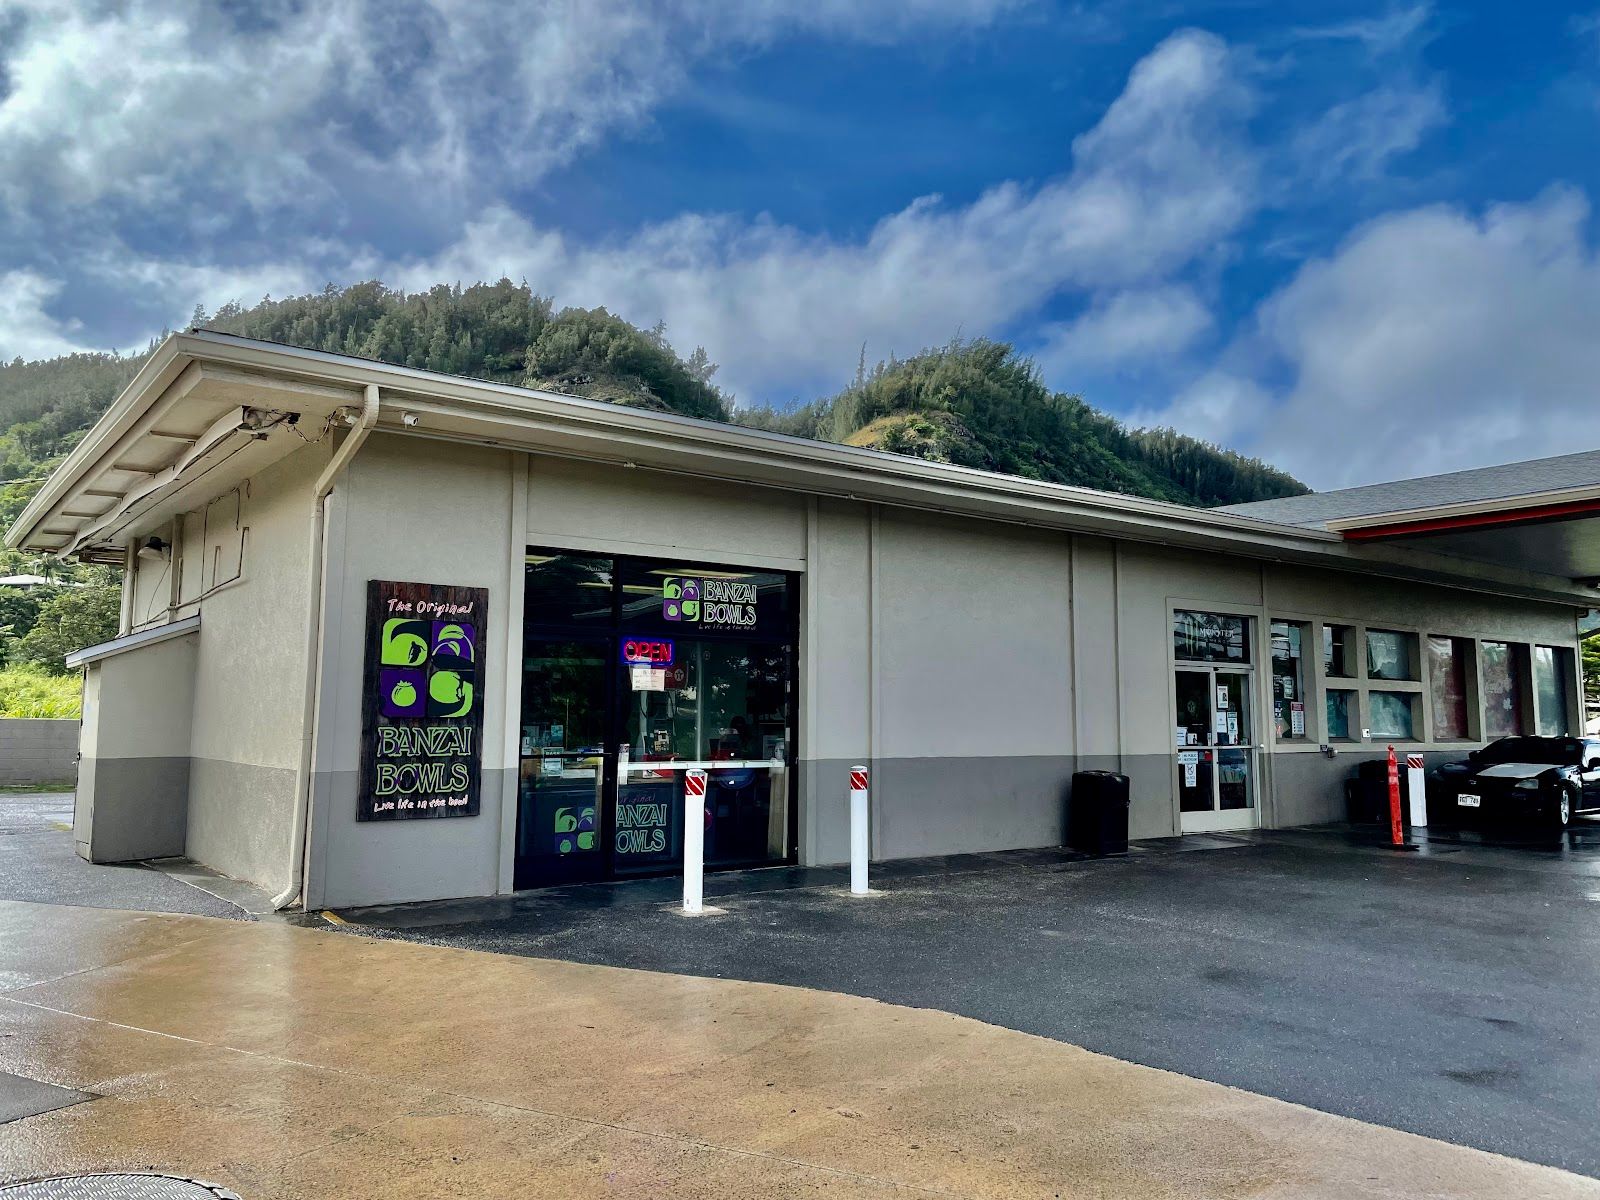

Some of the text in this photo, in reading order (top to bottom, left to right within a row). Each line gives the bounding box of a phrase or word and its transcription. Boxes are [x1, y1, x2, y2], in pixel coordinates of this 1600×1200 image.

[704, 580, 757, 604] BANZAI
[387, 598, 474, 618] The Original
[704, 602, 757, 625] BOWLS
[624, 641, 672, 662] OPEN
[377, 727, 472, 757] BANZAI
[376, 763, 470, 796] BOWLS
[616, 804, 667, 827] ANZAI
[616, 829, 666, 853] OWLS
